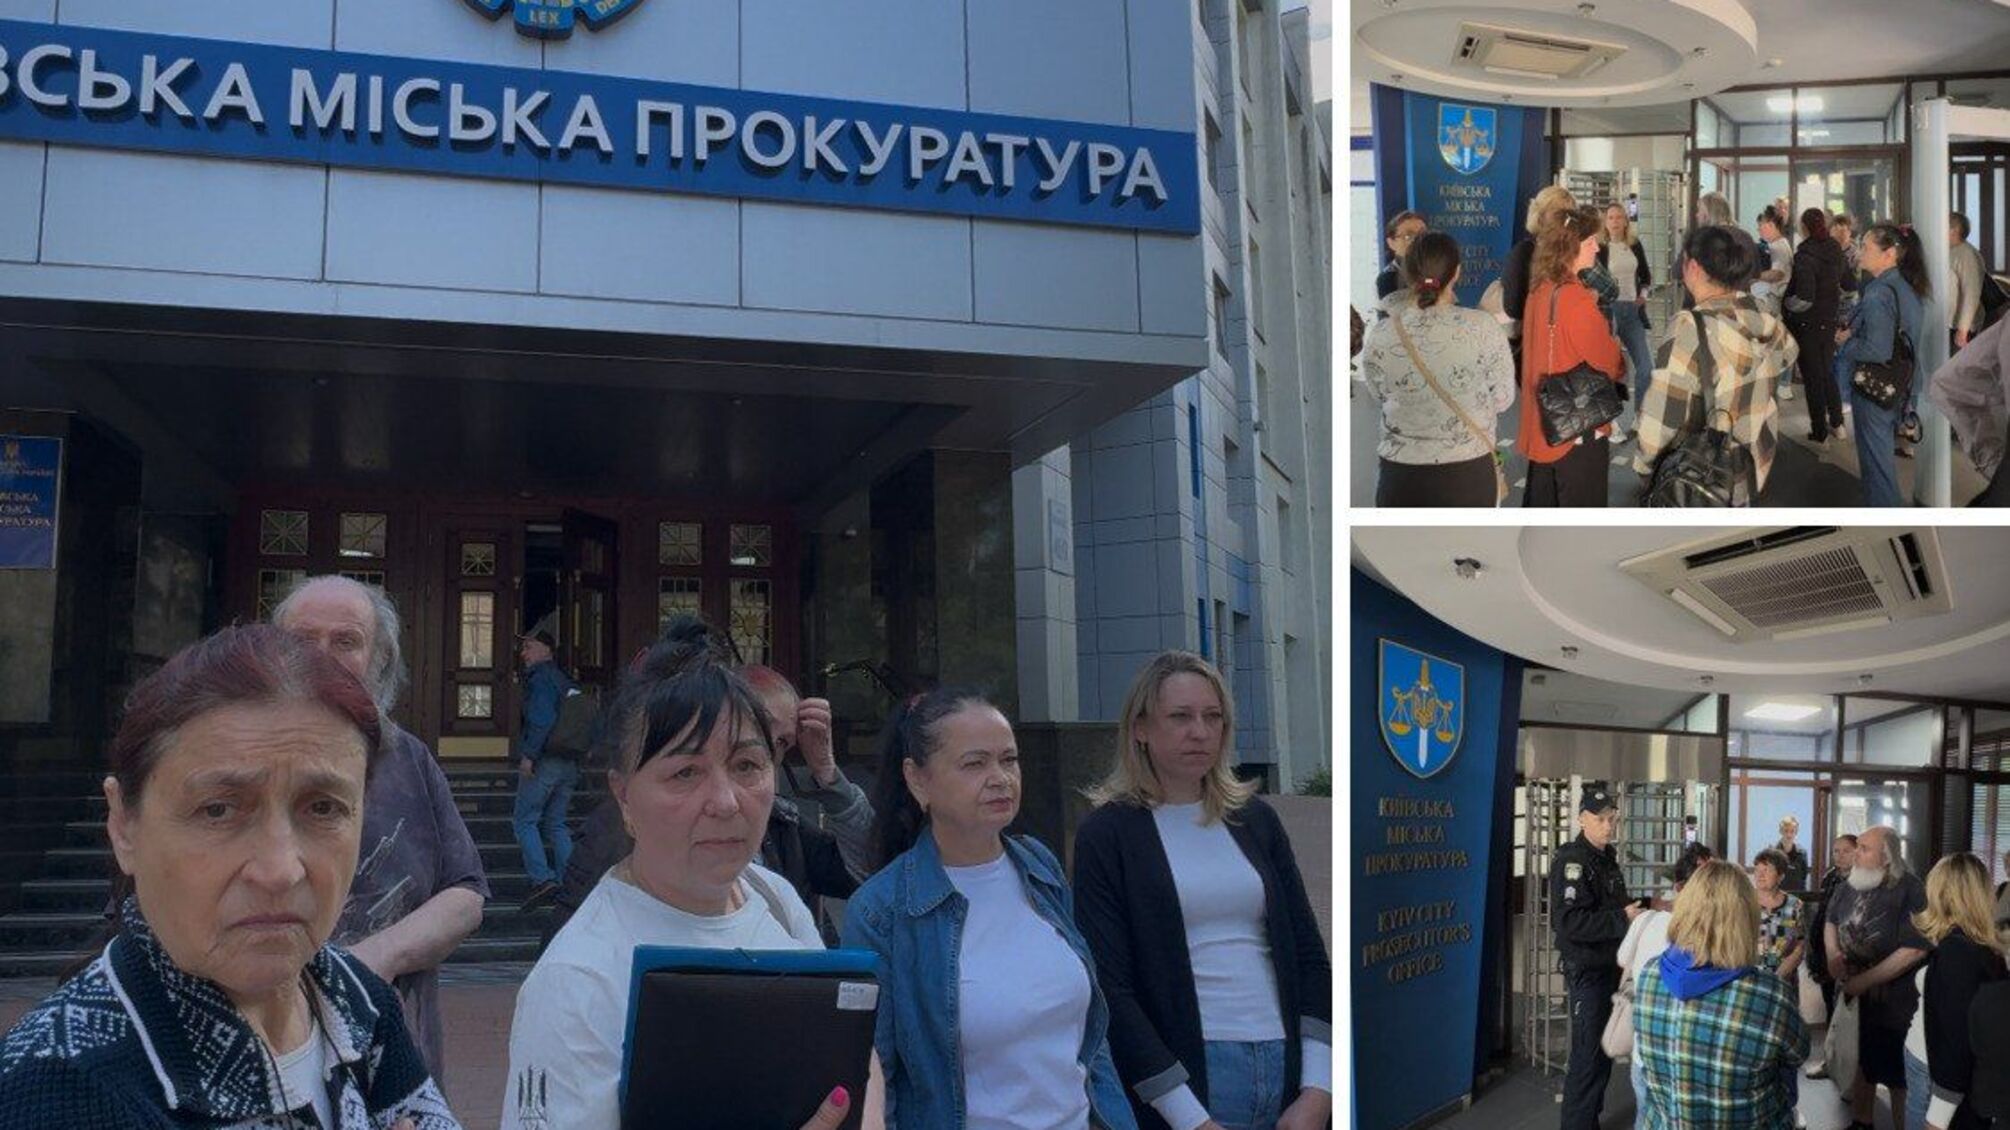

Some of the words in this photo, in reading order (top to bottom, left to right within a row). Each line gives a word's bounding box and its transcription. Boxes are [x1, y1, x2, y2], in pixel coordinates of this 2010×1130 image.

[530, 10, 559, 25] LEX
[288, 68, 614, 153] МІСЬКА
[635, 99, 1168, 200] ПРОКУРАТУРА
[1379, 797, 1454, 817] КИЇВСЬКА
[1386, 825, 1446, 845] МІСЬКА
[1365, 850, 1468, 875] ПРОКУРАТУРА
[1378, 906, 1415, 932] KYIV
[1415, 900, 1456, 923] CITY
